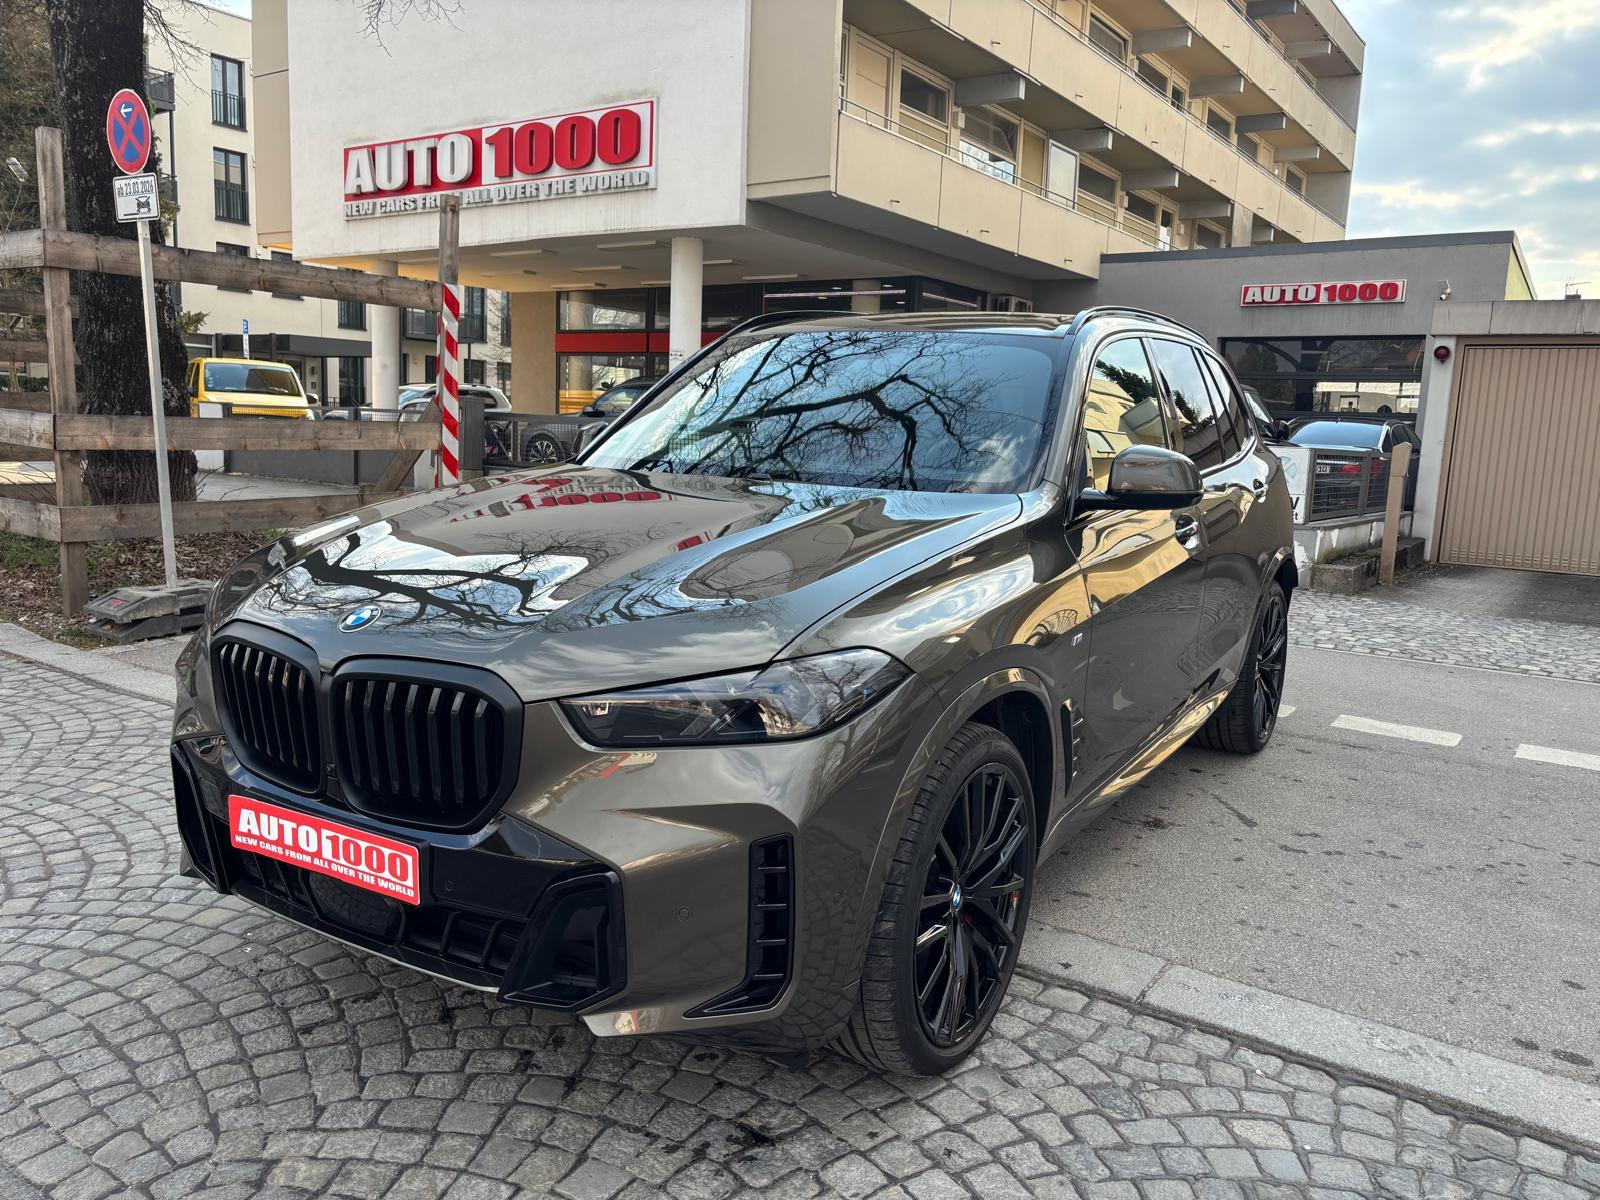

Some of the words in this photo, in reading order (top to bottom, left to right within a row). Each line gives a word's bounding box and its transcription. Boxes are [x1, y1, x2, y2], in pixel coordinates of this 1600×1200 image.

[345, 133, 473, 195] AUTO
[485, 109, 641, 178] 1000
[345, 201, 377, 217] NEW
[378, 196, 416, 213] CARS
[463, 188, 493, 205] ALL
[495, 183, 539, 201] OVER
[541, 178, 576, 197] THE
[577, 171, 649, 193] WORLD
[1244, 284, 1317, 303] AUTO
[1324, 282, 1399, 302] 1000
[235, 834, 258, 846] NEW
[259, 841, 284, 854] CARS
[285, 848, 311, 863] FROM
[313, 857, 329, 869] ALL
[331, 863, 356, 877] OVER
[357, 871, 376, 885] THE
[377, 878, 414, 897] WORLD
[238, 808, 318, 853] AUTO
[326, 834, 409, 882] 1000
